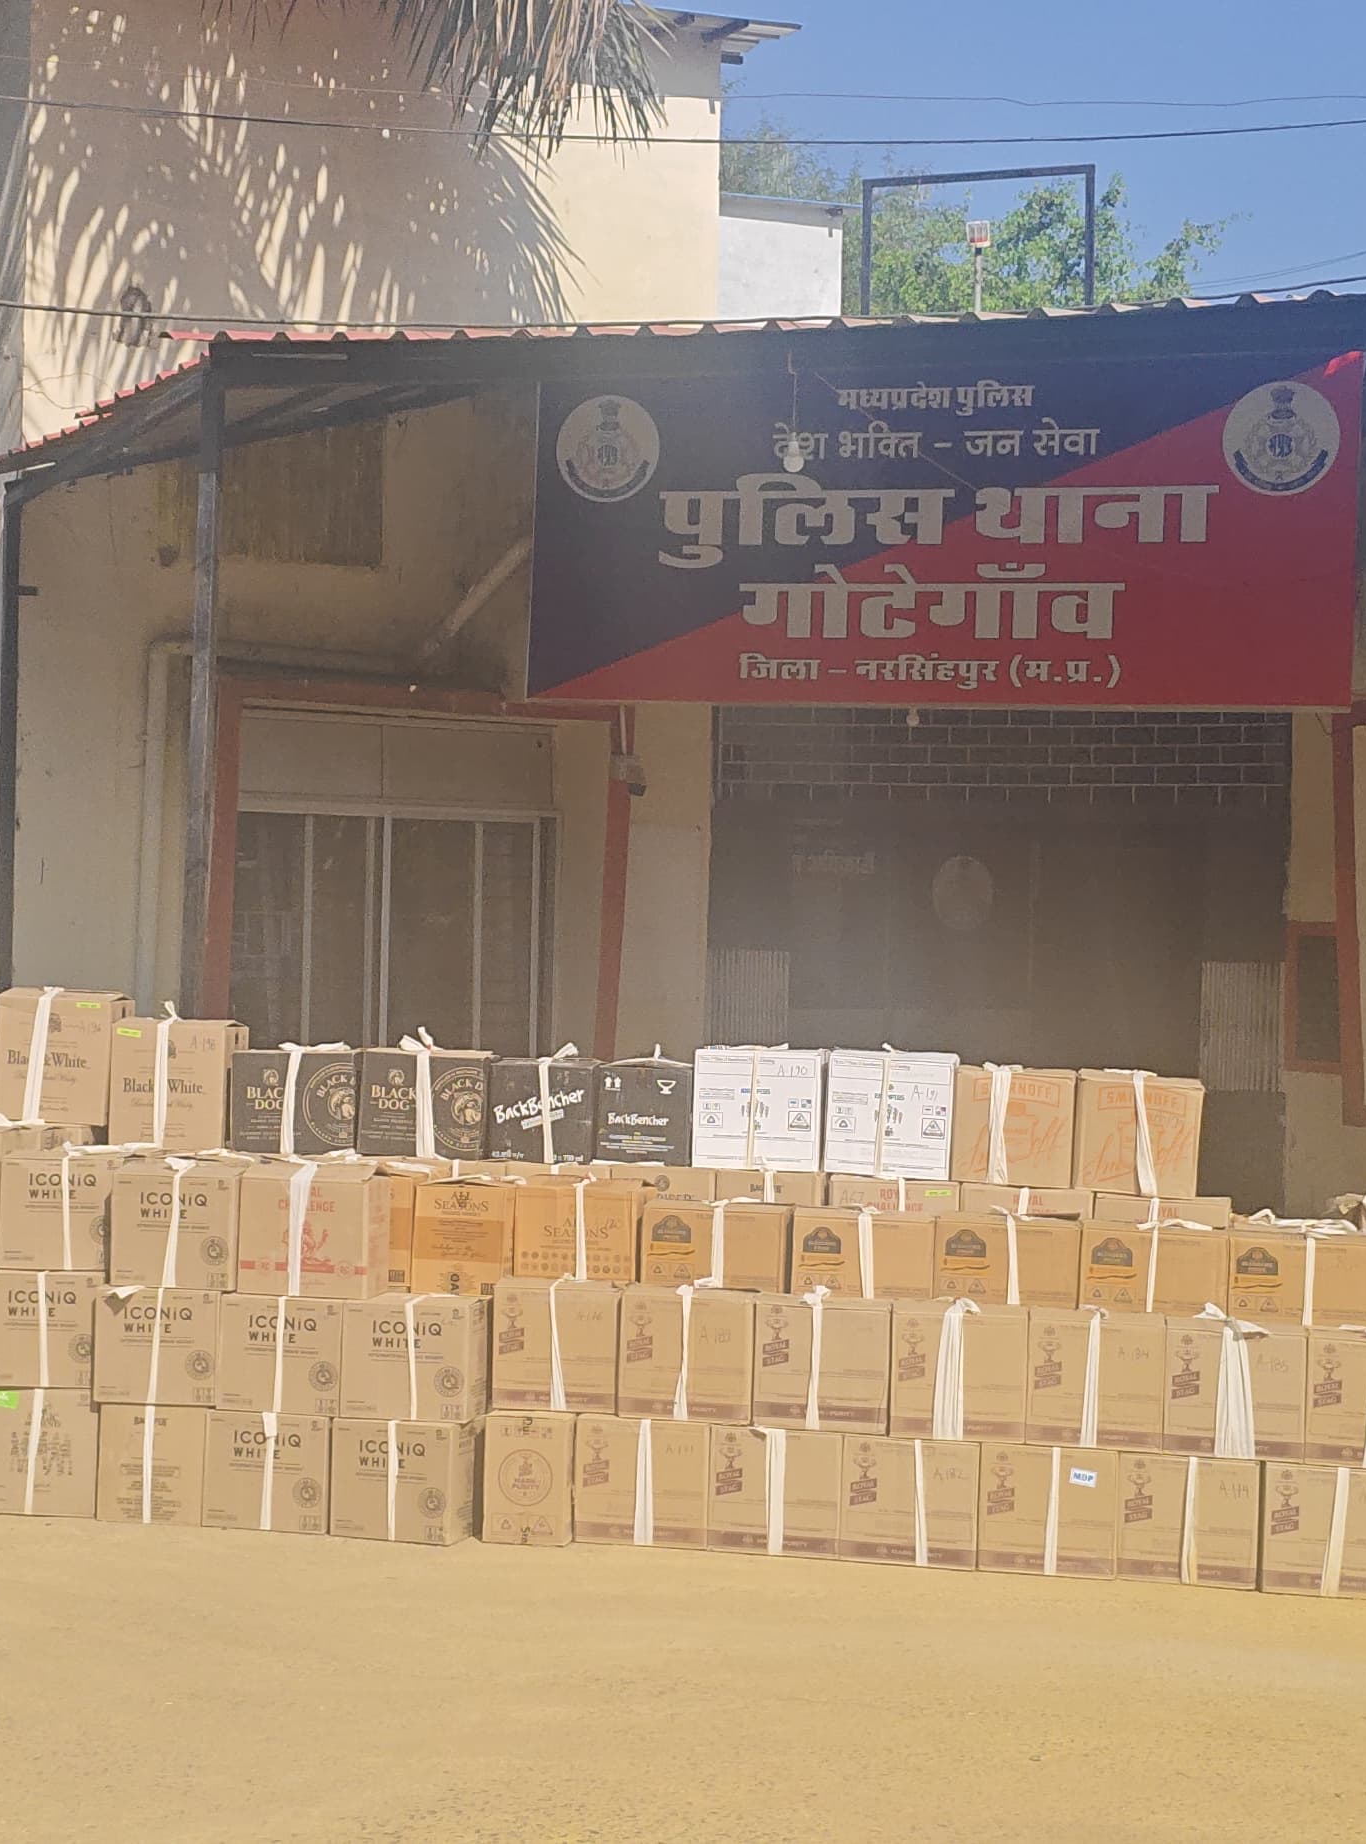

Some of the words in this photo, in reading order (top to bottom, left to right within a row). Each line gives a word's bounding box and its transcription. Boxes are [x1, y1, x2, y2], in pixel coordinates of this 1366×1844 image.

[836, 381, 953, 411] मध्यप्रदेश
[955, 380, 1035, 416] पुलिस
[839, 420, 922, 458] भक्ति
[963, 430, 1024, 457] जन
[1032, 417, 1100, 456] सेवा
[657, 473, 955, 569] पुलिस
[975, 482, 1220, 545] थाना
[740, 563, 1125, 641] गोटेगाँव
[739, 652, 821, 683] जिला
[854, 652, 999, 689] नरसिंहपुर
[1009, 654, 1122, 689] (म.प्र.)
[247, 1087, 284, 1099] BLAC
[371, 1085, 416, 1099] BLACK
[982, 1085, 1052, 1099] SRNOFF
[378, 1100, 410, 1110] DOG
[880, 1188, 911, 1200] ROYL
[140, 1208, 188, 1219] WHIE
[8, 1307, 55, 1317] WHIE
[124, 1323, 171, 1334] WHIE
[249, 1331, 296, 1344] WHIE
[233, 1447, 281, 1460] WHIE
[359, 1456, 405, 1469] WHIE
